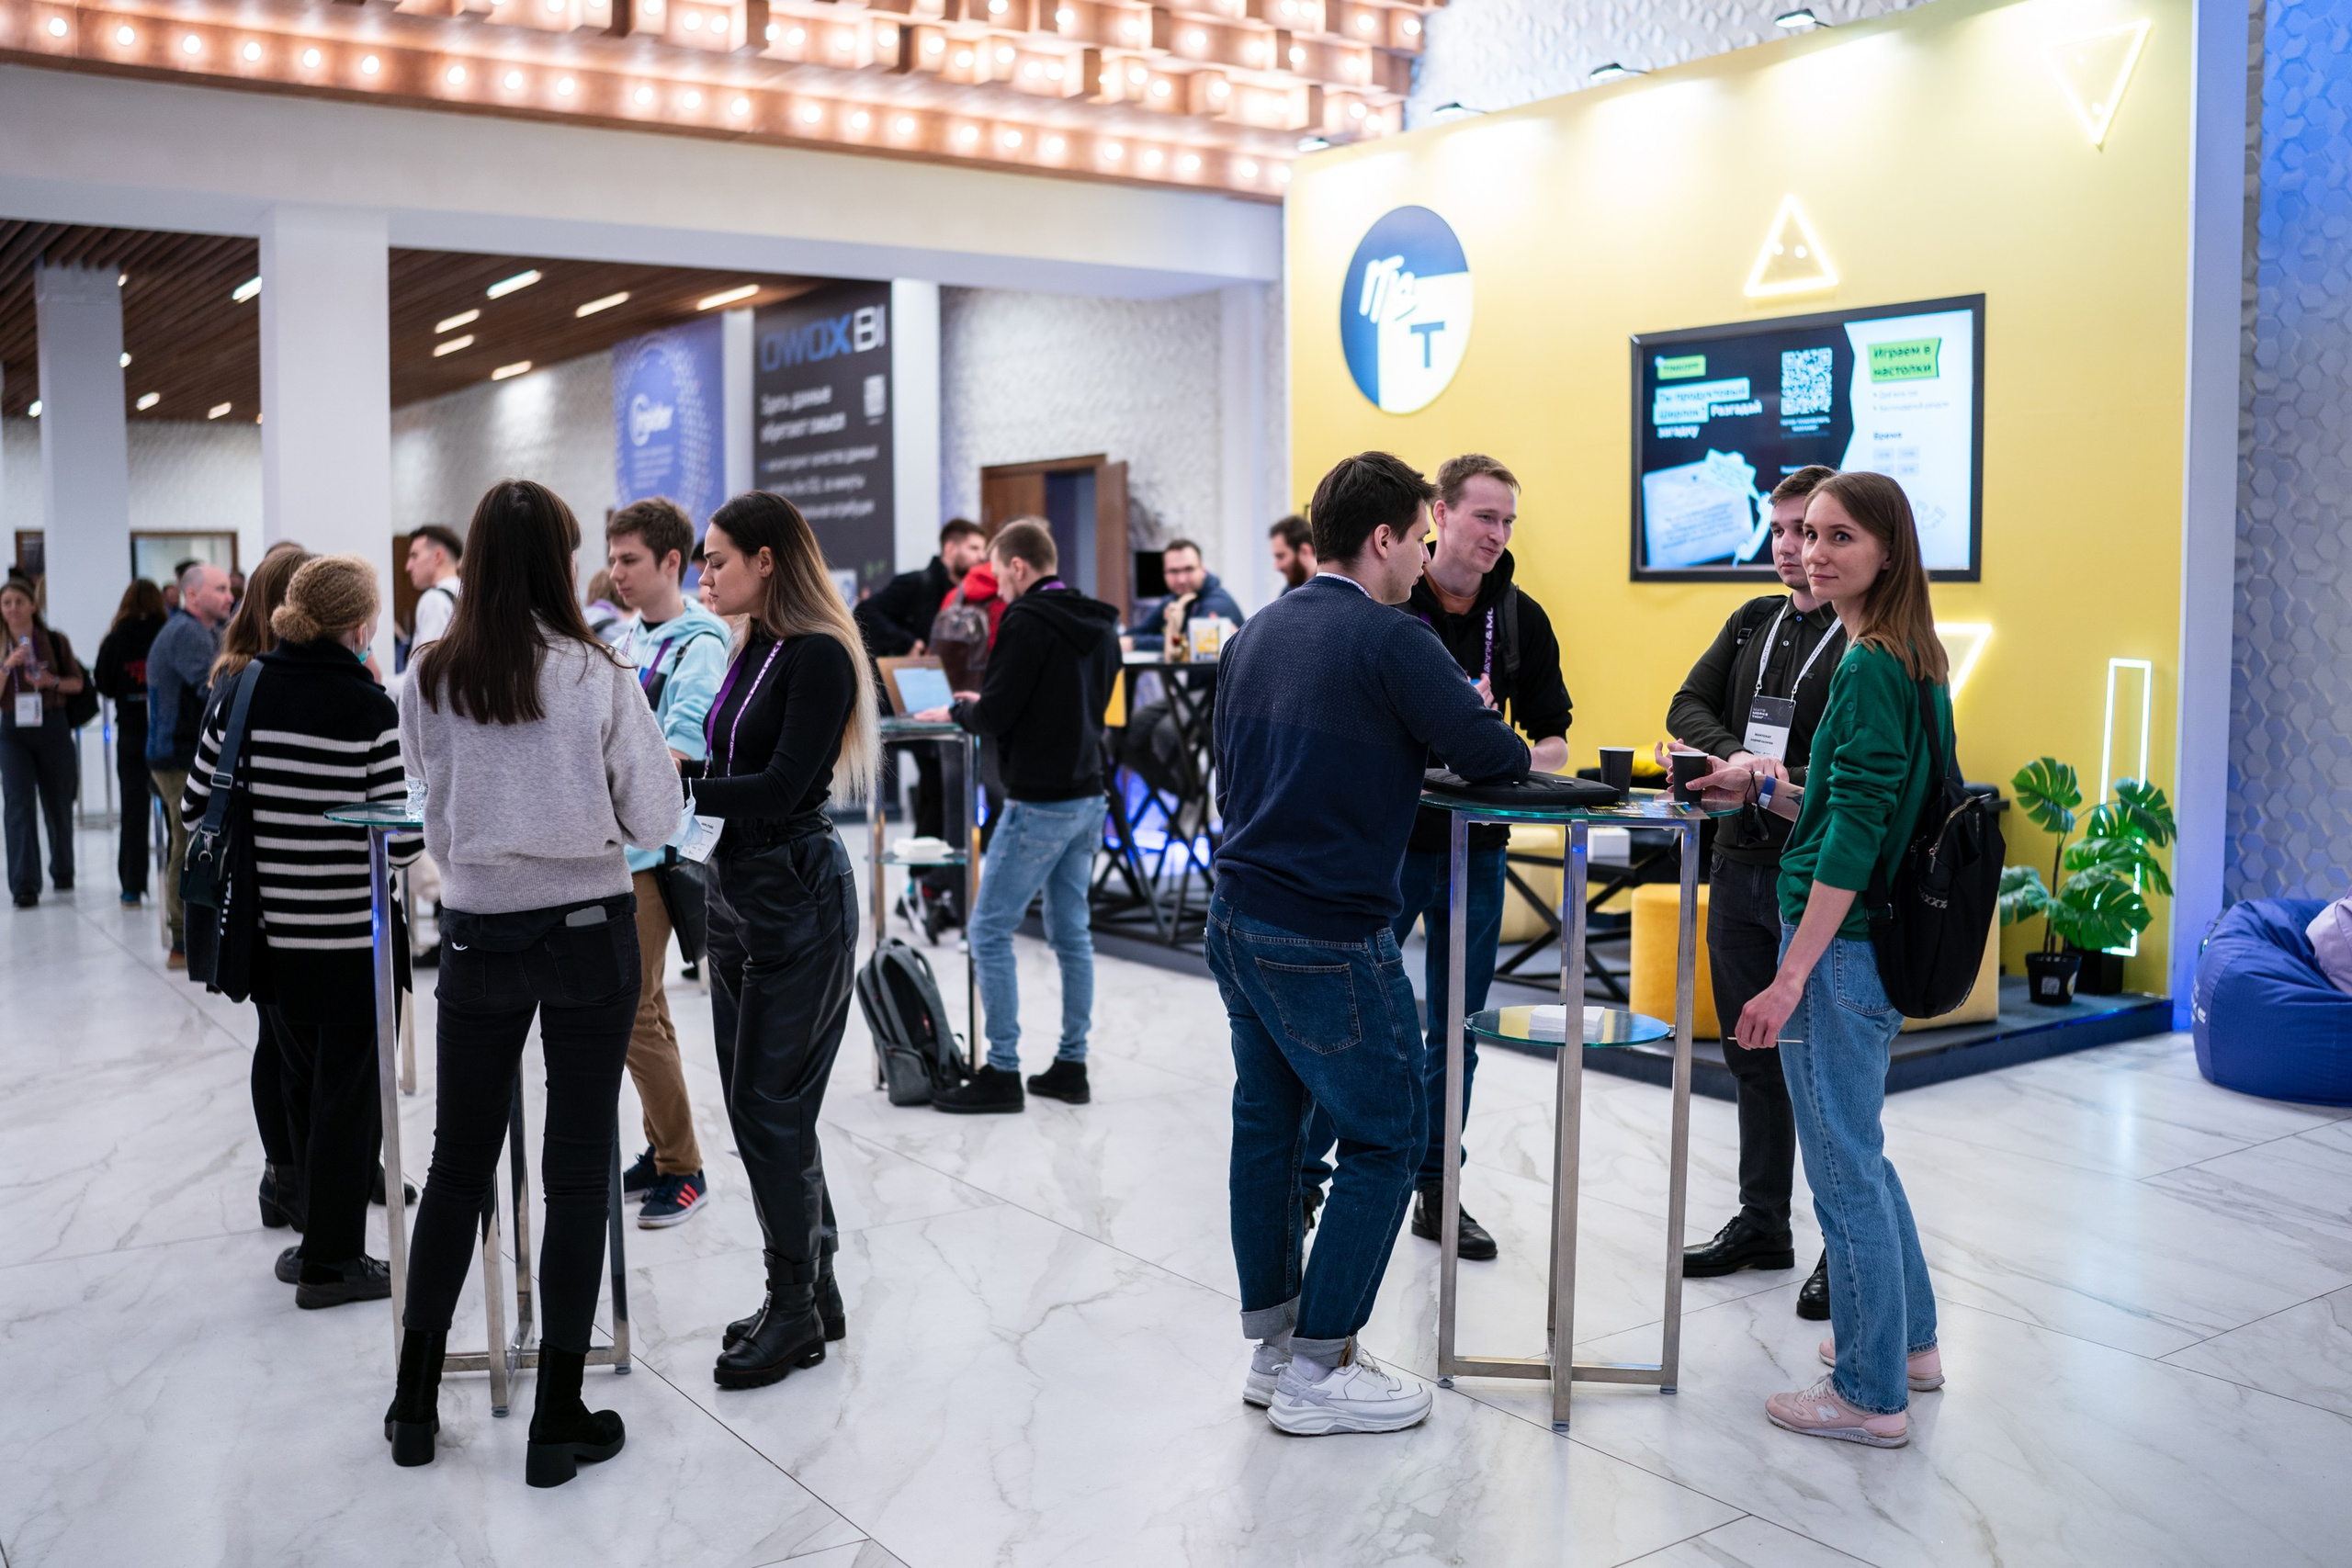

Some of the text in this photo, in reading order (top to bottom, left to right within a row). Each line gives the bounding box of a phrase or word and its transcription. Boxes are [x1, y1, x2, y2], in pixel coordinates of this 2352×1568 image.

[761, 304, 886, 371] OWOX BI
[1873, 345, 1931, 359] Играем в
[1873, 365, 1932, 377] настолки
